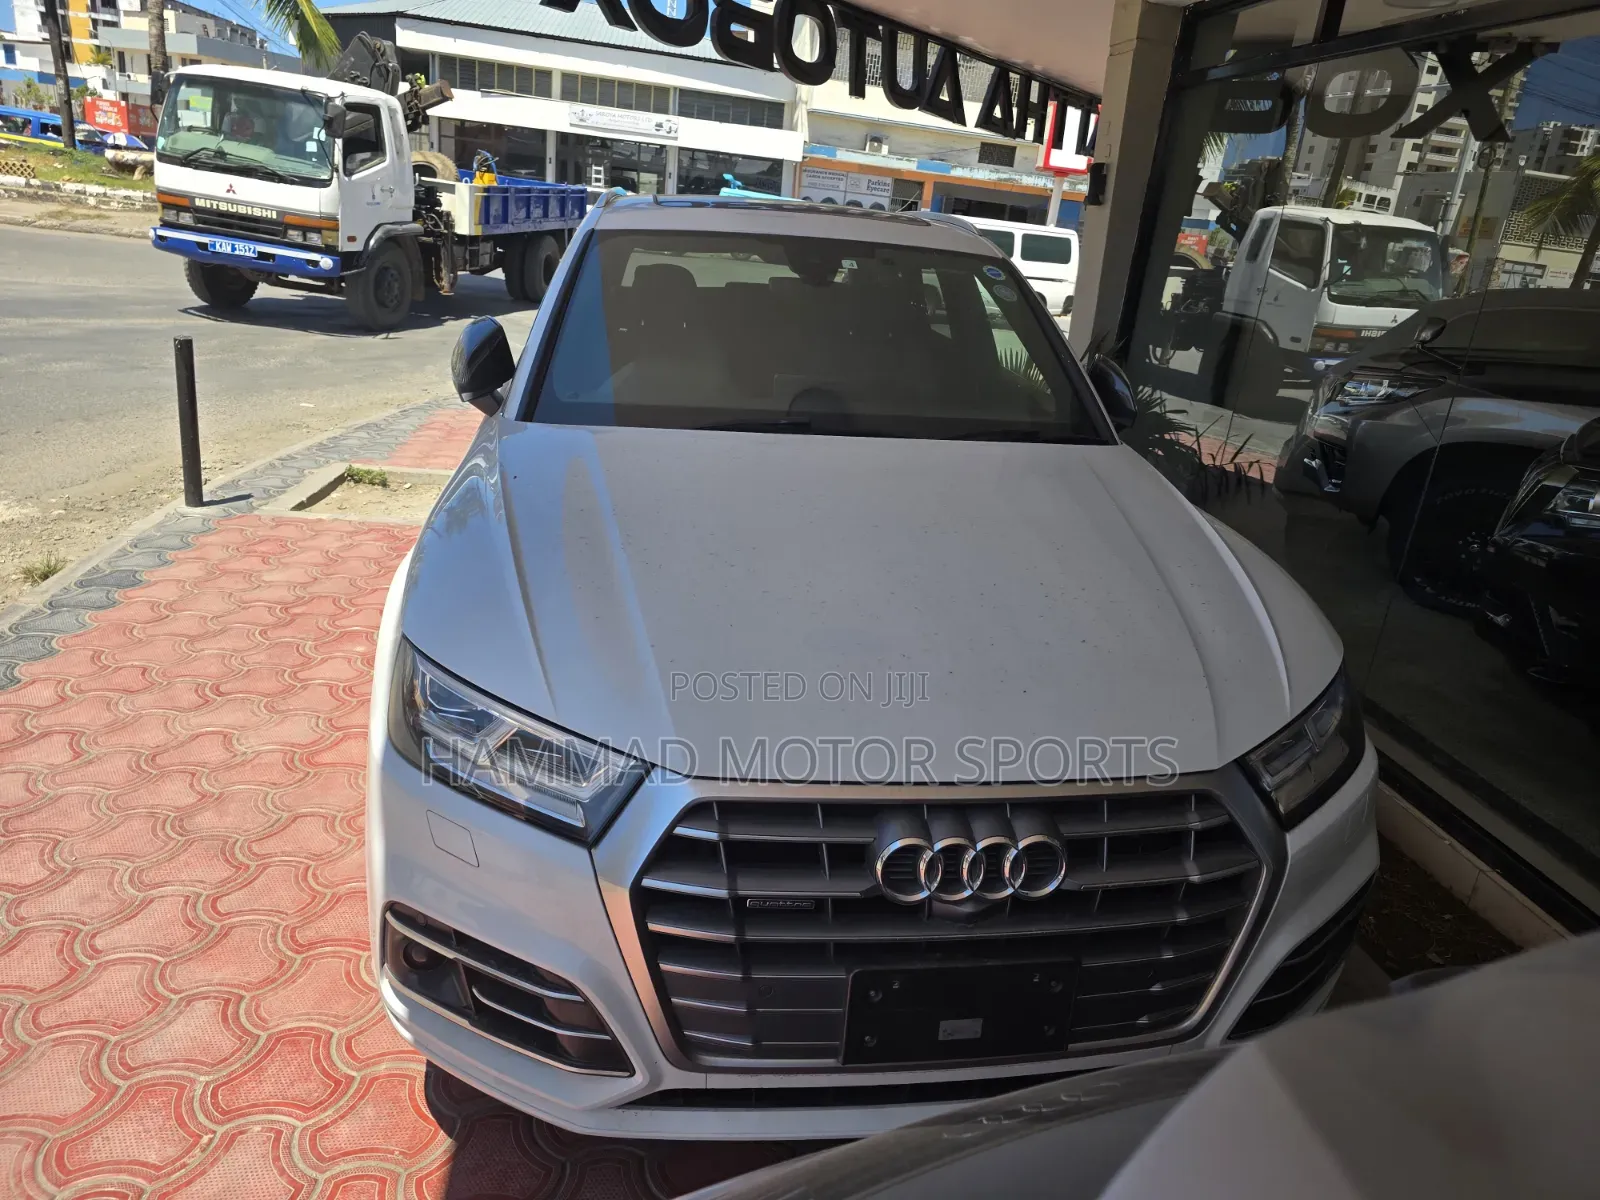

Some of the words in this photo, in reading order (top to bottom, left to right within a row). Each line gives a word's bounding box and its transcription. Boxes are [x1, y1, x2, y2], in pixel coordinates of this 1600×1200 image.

[867, 179, 890, 187] Parkins
[866, 185, 890, 193] Eyecare
[195, 198, 277, 219] MITSUBISHI
[216, 240, 232, 254] KAW
